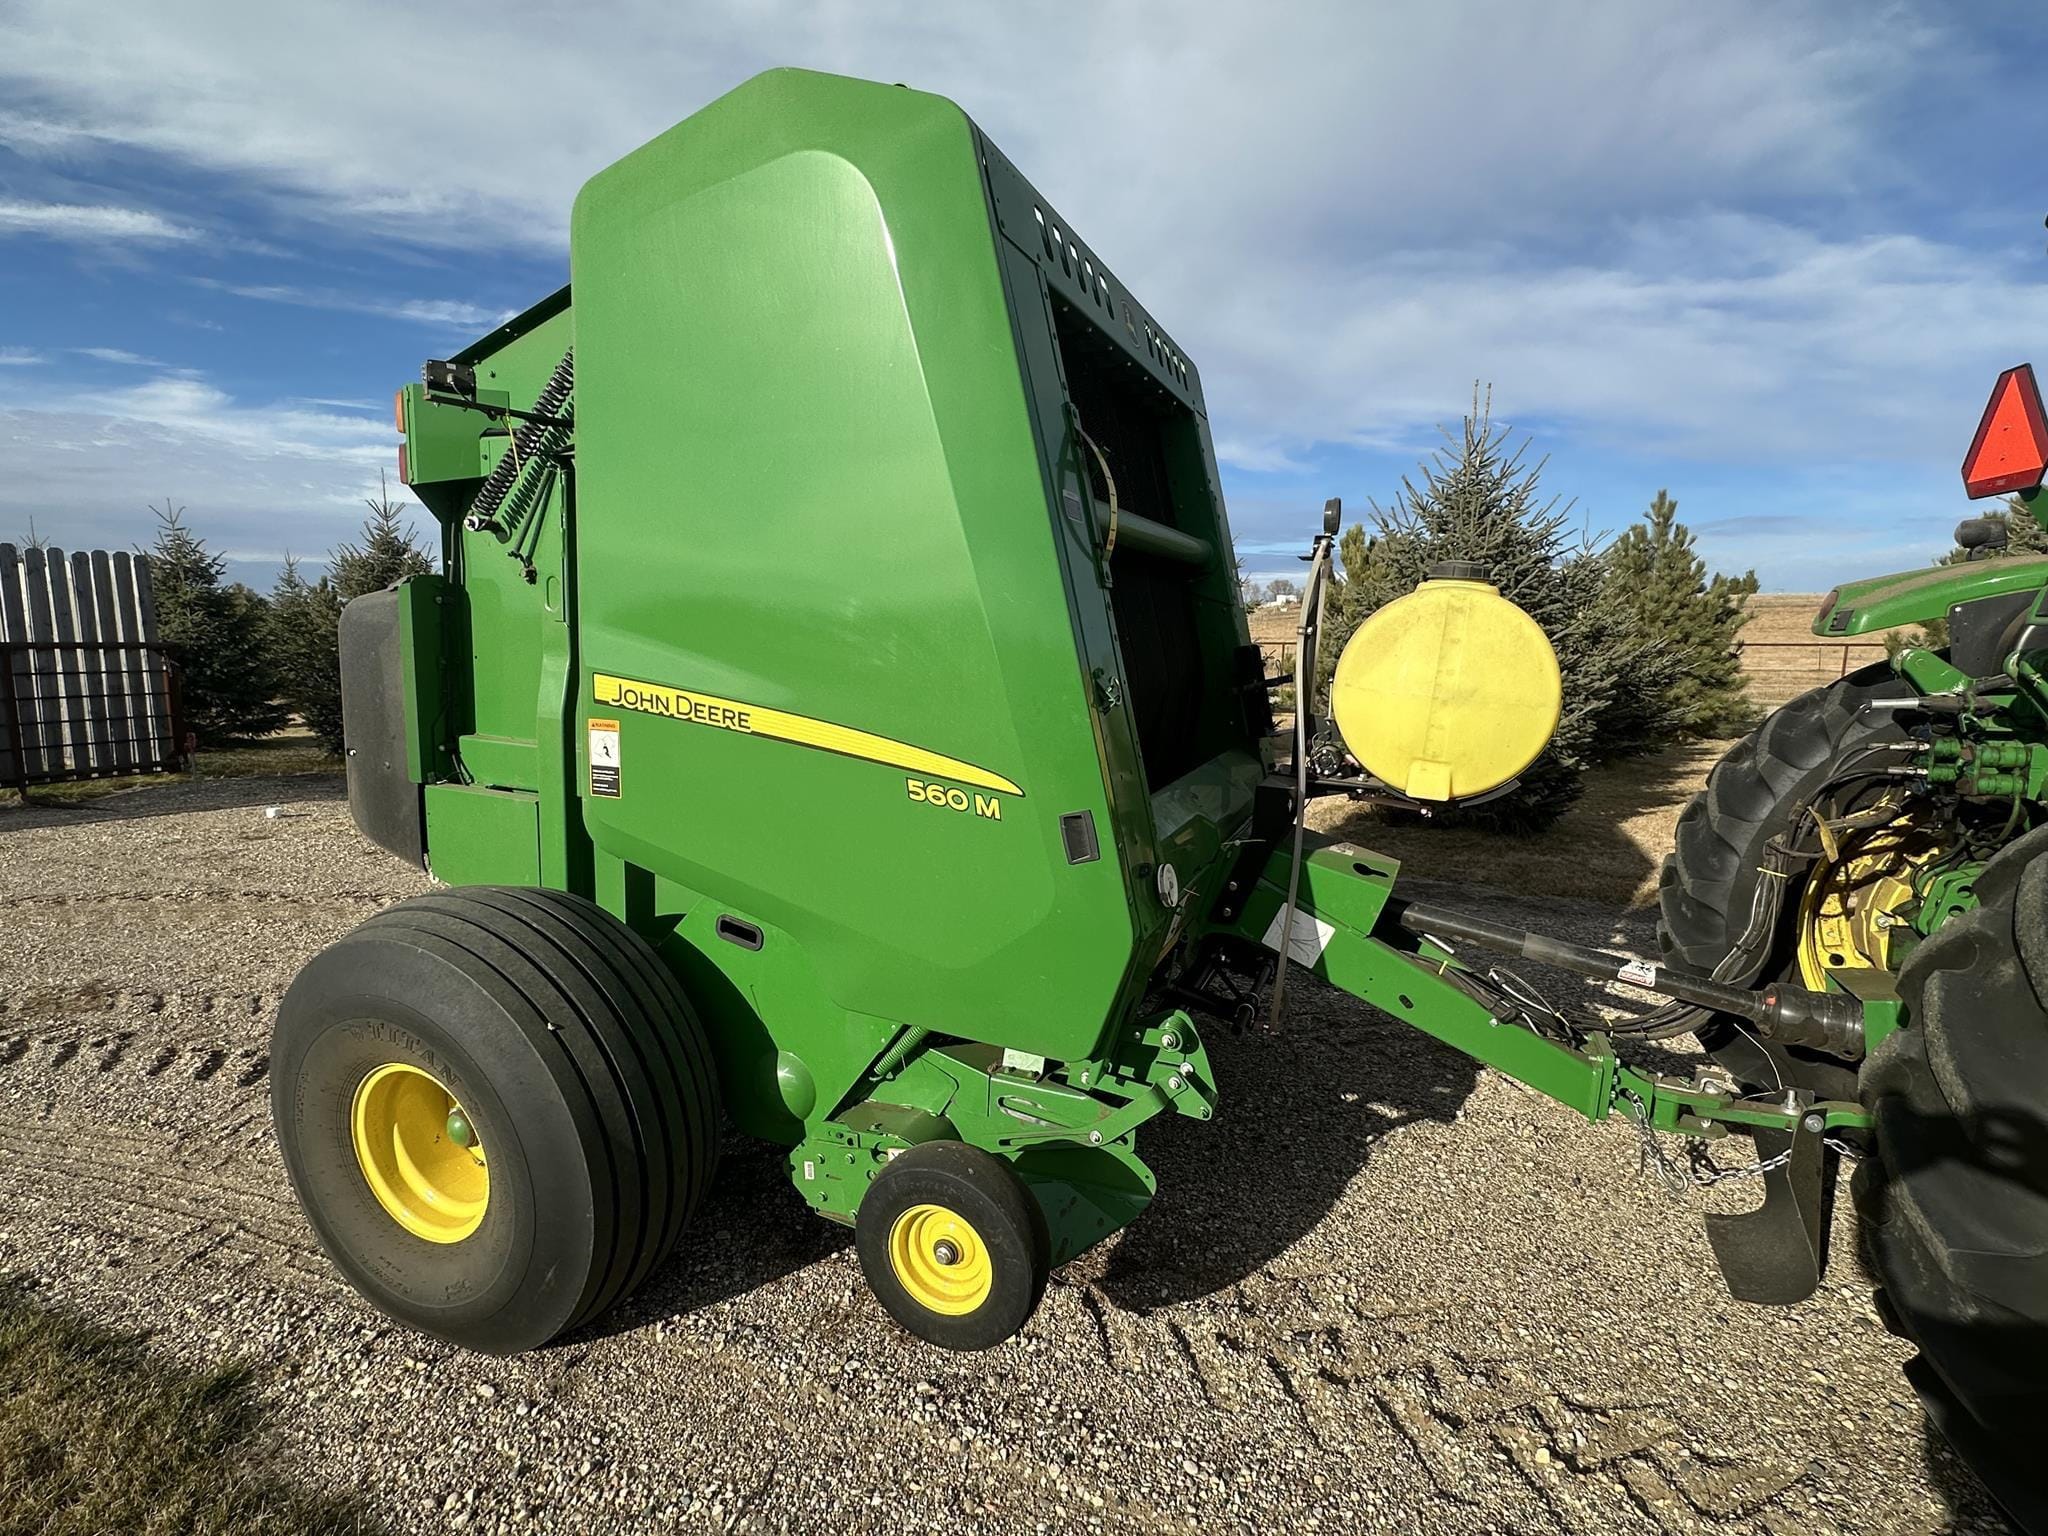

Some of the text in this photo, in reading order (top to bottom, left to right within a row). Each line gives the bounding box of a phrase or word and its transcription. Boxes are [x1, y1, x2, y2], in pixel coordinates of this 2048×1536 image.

[611, 683, 751, 730] JOHN DEERE
[906, 777, 1002, 821] 560 M
[368, 1021, 461, 1086] TITAN
